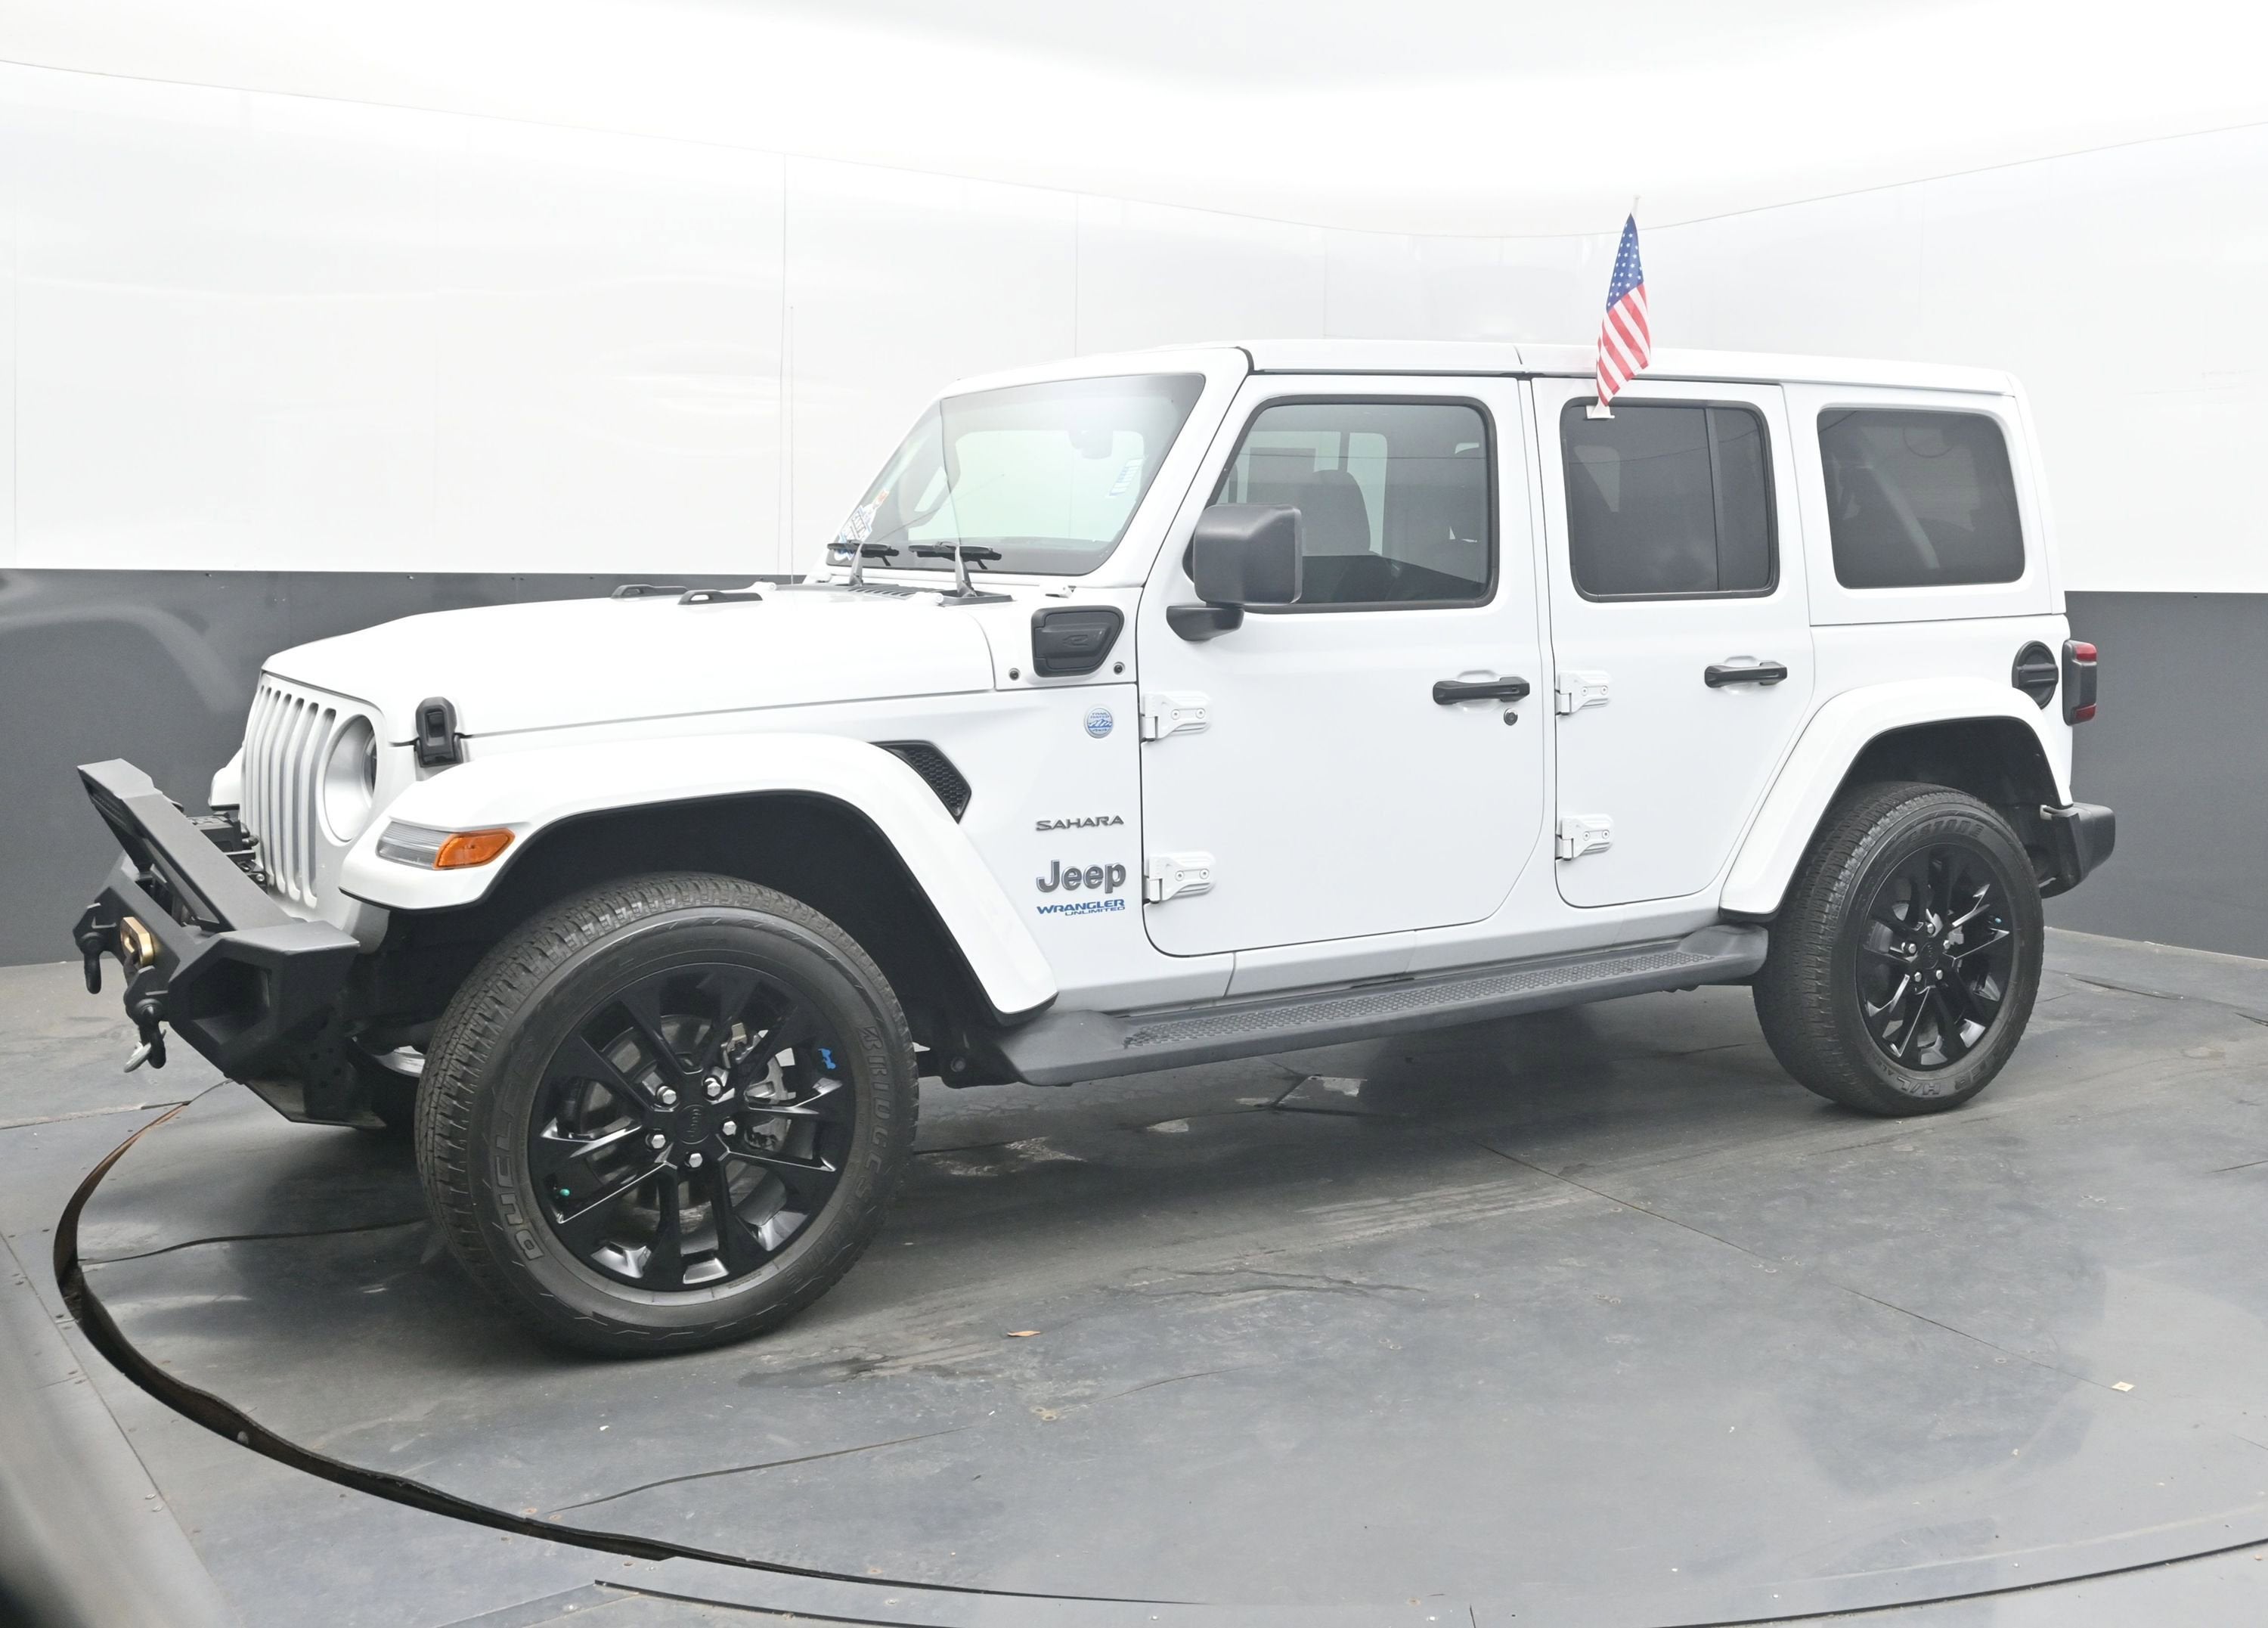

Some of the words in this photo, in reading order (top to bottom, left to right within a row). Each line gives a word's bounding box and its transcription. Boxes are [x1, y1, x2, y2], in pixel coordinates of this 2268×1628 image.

[1035, 815, 1124, 832] SAHARA
[1036, 859, 1126, 894] Jeep
[1036, 898, 1125, 914] WRANGLER
[1064, 906, 1126, 916] UNLIMITED
